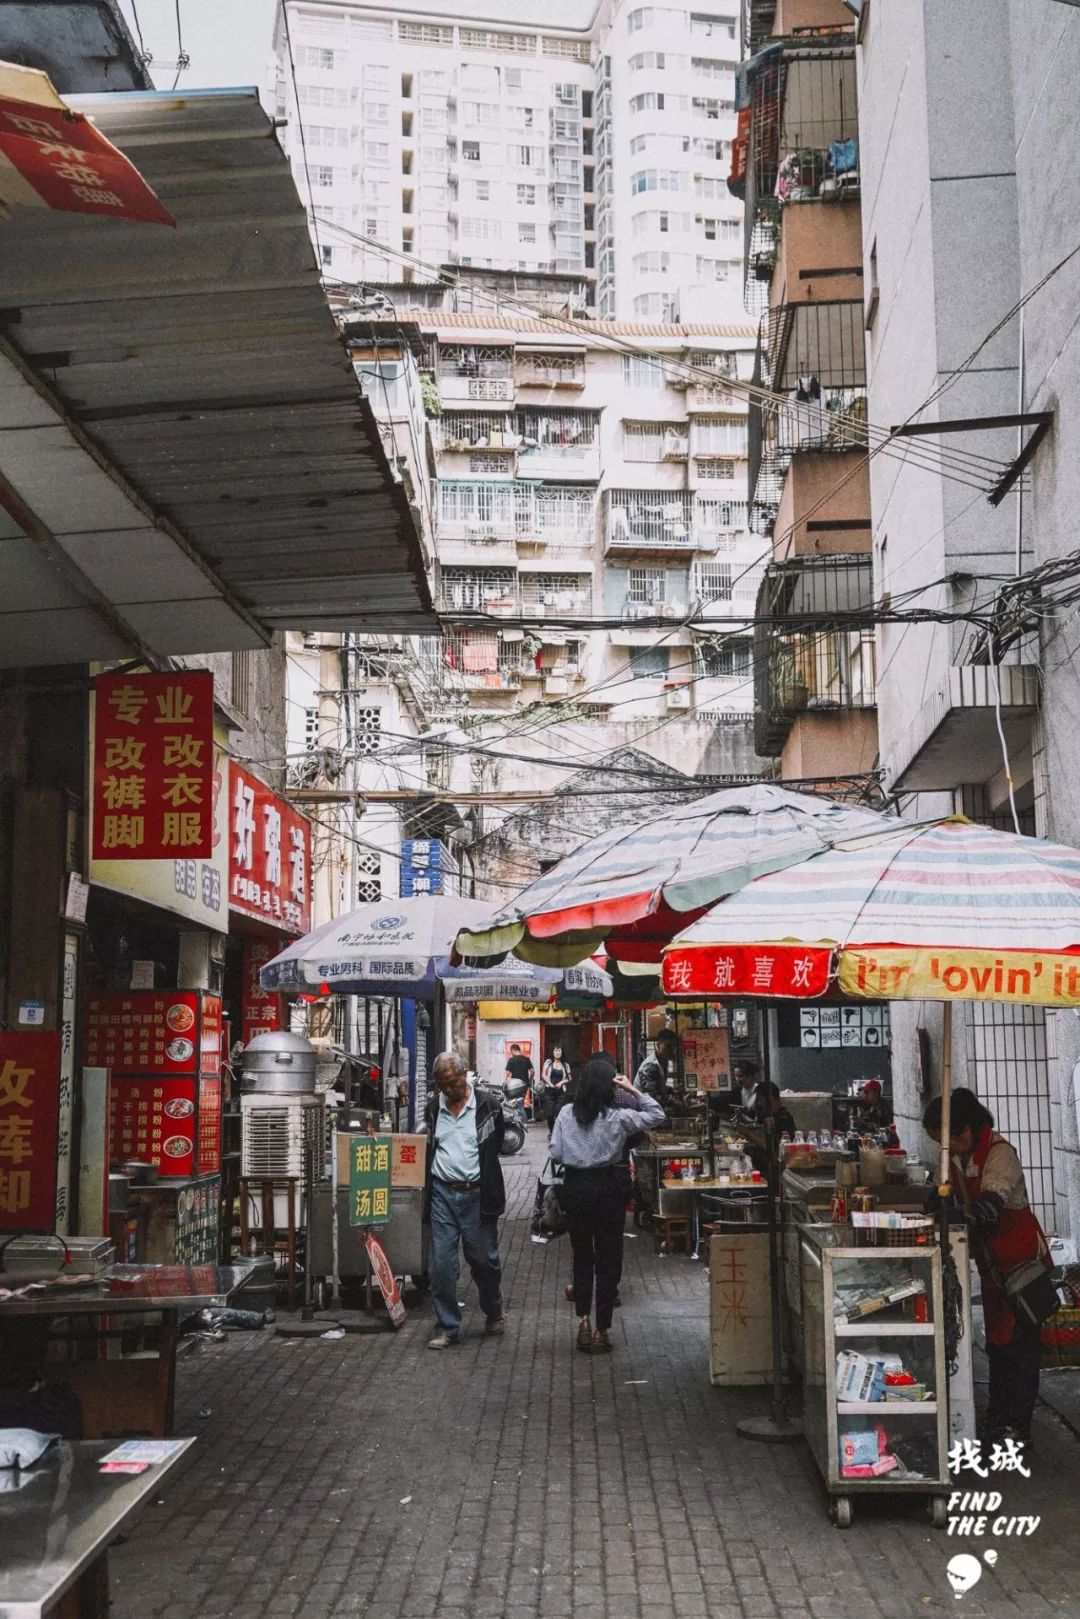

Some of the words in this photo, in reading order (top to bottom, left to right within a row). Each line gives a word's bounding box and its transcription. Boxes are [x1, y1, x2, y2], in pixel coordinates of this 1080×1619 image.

[108, 685, 193, 725] 专业
[102, 736, 147, 848] 改裤脚
[160, 736, 204, 847] 改衣服
[318, 961, 363, 978] 专业男科
[369, 961, 414, 975] 国际品质
[668, 956, 814, 988] 我就喜欢
[246, 1012, 279, 1028] 正宗
[355, 1144, 389, 1173] 甜酒
[400, 1144, 417, 1164] 蛋
[355, 1187, 389, 1217] 汤圆
[715, 1247, 749, 1331] 玉米
